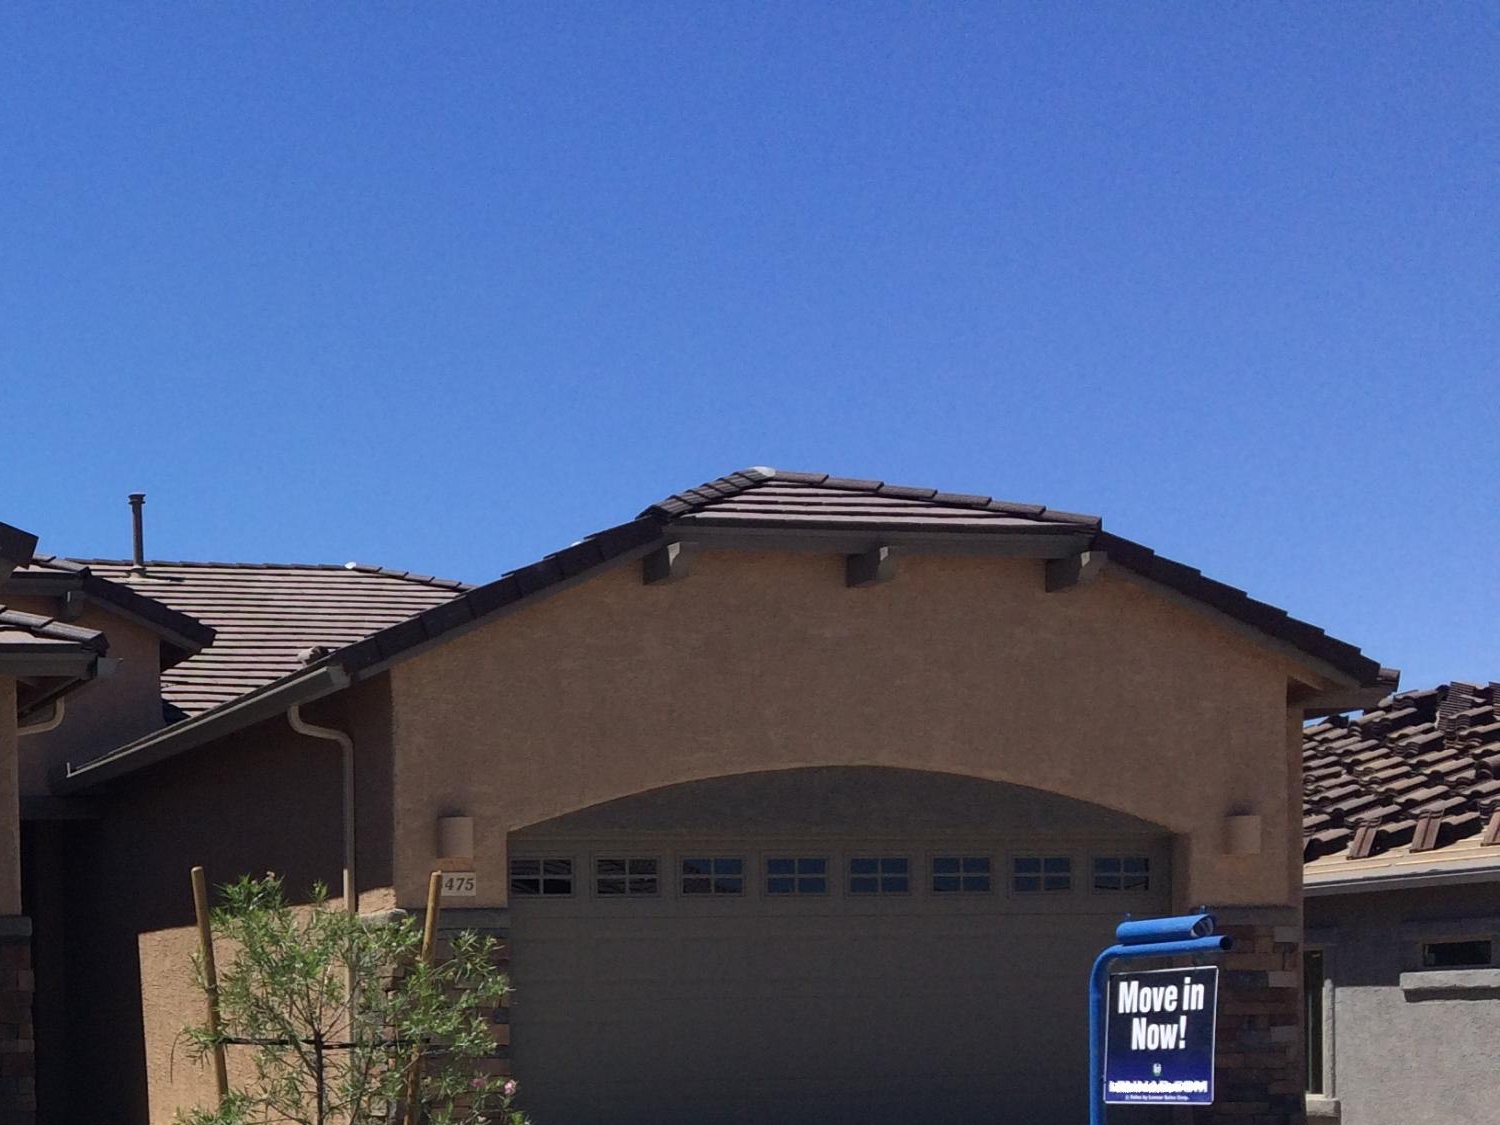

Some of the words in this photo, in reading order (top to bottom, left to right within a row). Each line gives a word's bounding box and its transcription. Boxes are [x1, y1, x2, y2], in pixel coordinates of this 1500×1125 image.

[1117, 980, 1178, 1014] Move
[1182, 976, 1205, 1011] in
[1131, 1015, 1187, 1050] Now!
